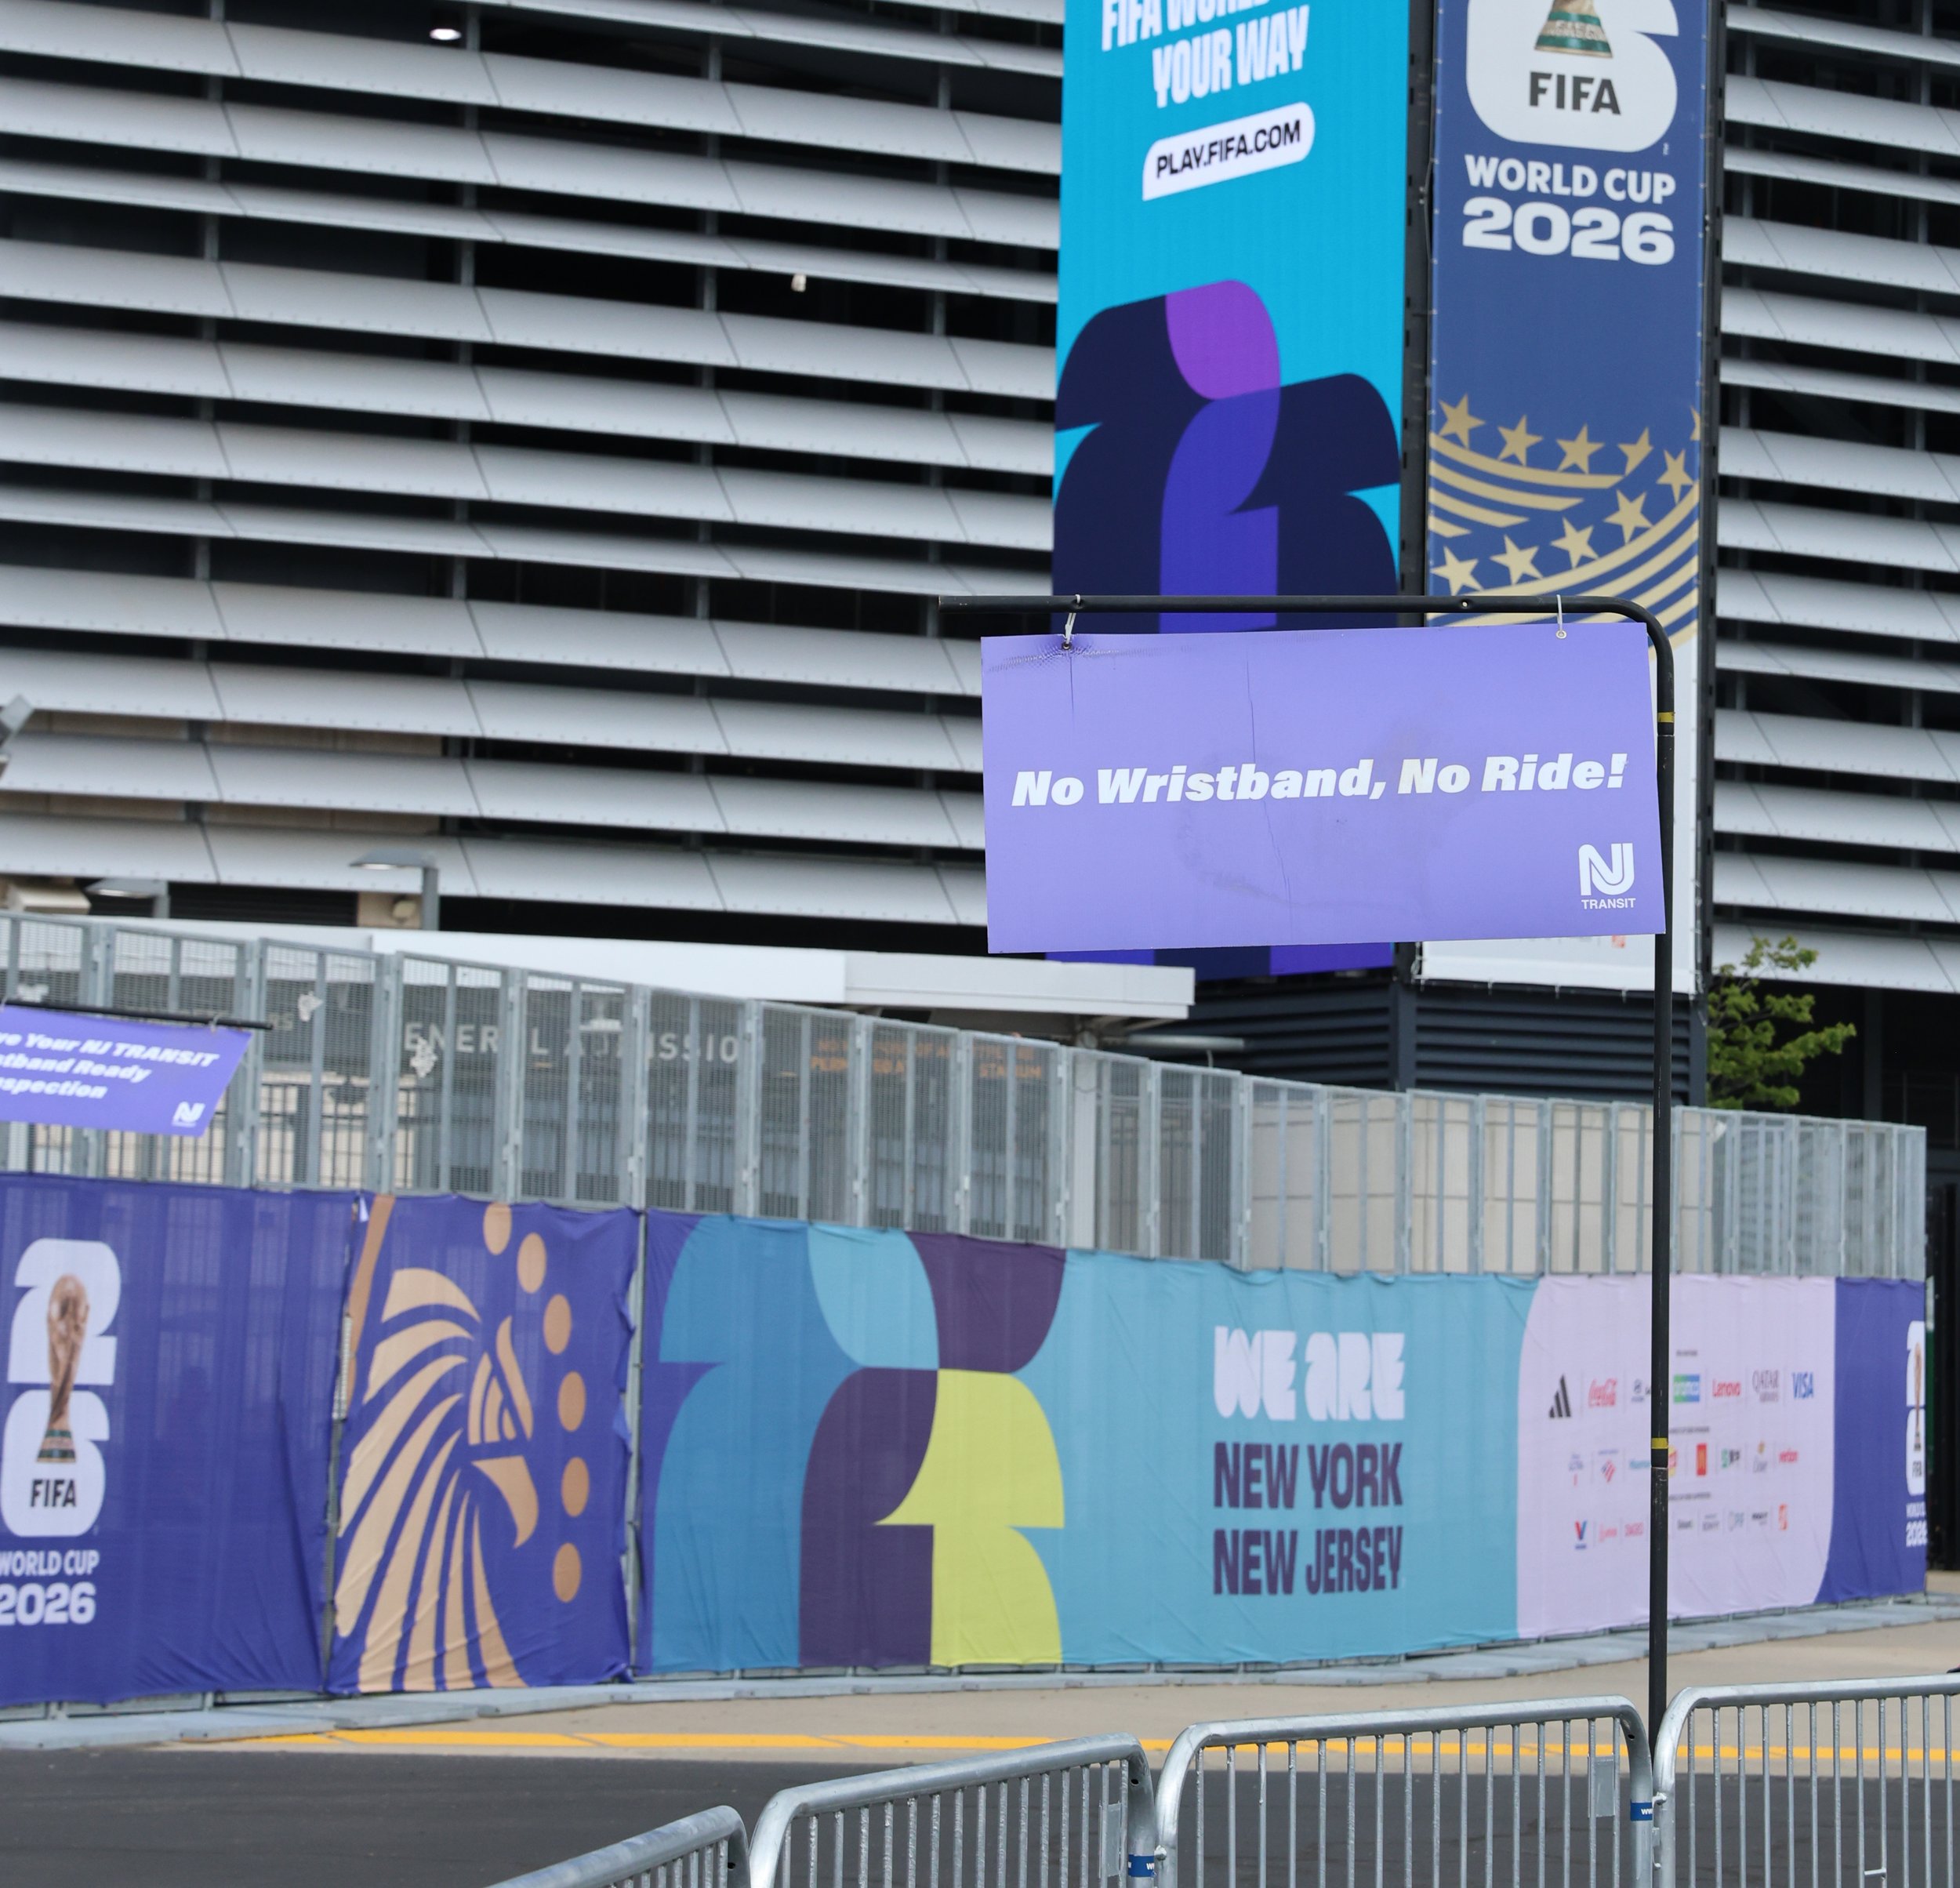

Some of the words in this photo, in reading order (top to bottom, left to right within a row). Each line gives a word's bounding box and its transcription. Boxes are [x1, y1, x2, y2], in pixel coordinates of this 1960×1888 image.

[1102, 0, 1162, 52] FIFA
[1152, 28, 1232, 108] YOUR
[1236, 4, 1310, 85] WAY
[1529, 71, 1622, 115] FIFA
[1156, 119, 1301, 179] PLAY.FIFA.COM
[1465, 154, 1599, 198] WORLD
[1603, 168, 1676, 205] CUP
[1462, 196, 1675, 265] 2026
[1011, 771, 1085, 807] No
[1098, 758, 1387, 804] Wristband,
[1397, 758, 1471, 794] No
[1481, 753, 1628, 792] Ride!
[1578, 842, 1635, 895] NJ
[1581, 898, 1636, 910] TRANSIT
[0, 1053, 76, 1073] tband
[72, 1059, 152, 1084] Ready
[24, 1033, 81, 1052] Your
[79, 1039, 113, 1055] NJ
[112, 1042, 220, 1067] TRANSIT
[0, 1077, 108, 1099] spection
[1214, 1326, 1297, 1421] WE
[31, 1479, 76, 1508] FIFA
[1214, 1442, 1299, 1509] NEW
[1307, 1442, 1403, 1510] YORK
[0, 1551, 62, 1577] WORLD
[64, 1549, 100, 1575] CUP
[1213, 1529, 1298, 1596] NEW
[1306, 1526, 1403, 1595] JERSEY
[0, 1581, 96, 1626] 2026
